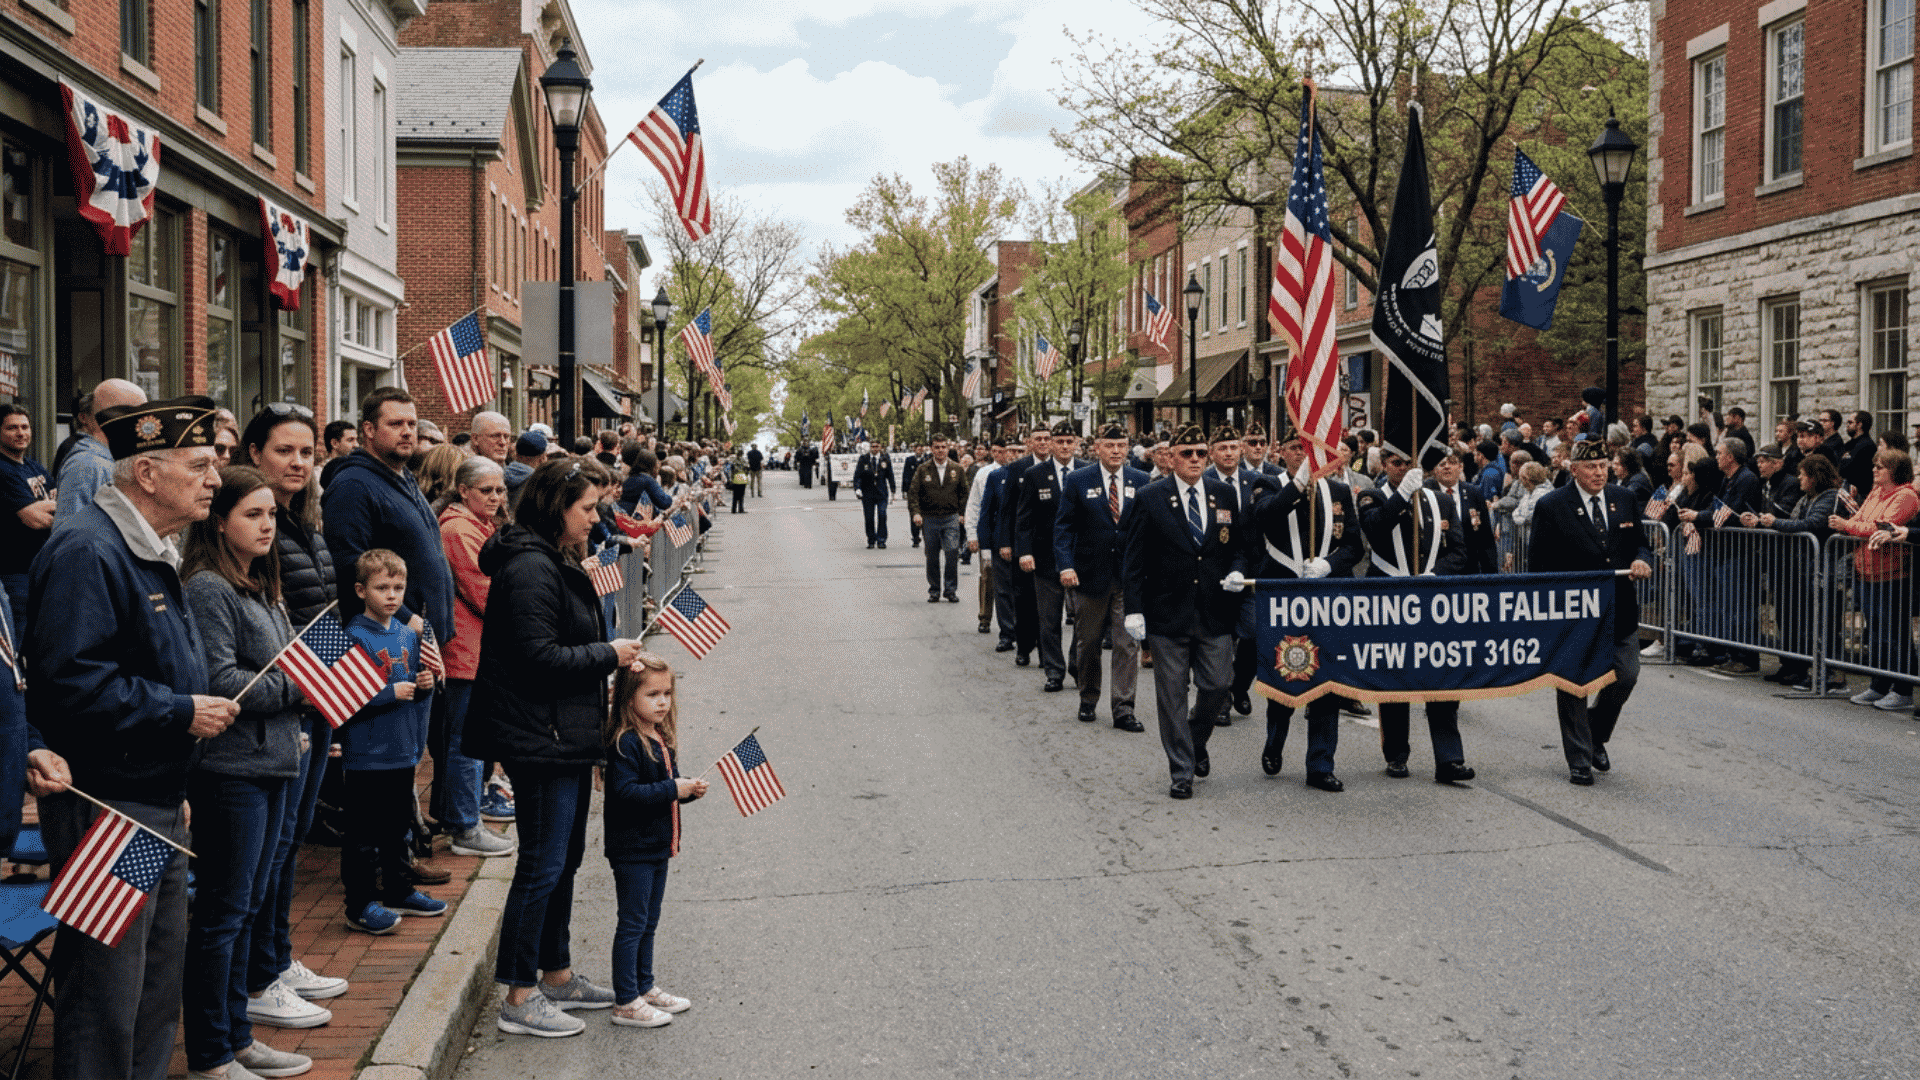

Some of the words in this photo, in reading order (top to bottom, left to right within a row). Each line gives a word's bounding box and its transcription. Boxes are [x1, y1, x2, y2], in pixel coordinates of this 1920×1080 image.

[1269, 595, 1422, 627] HONORING
[1430, 592, 1491, 625] OUR
[1499, 588, 1601, 622] FALLEN
[1352, 642, 1407, 670] VFW
[1413, 640, 1477, 669] POST
[1484, 637, 1541, 666] 3162
